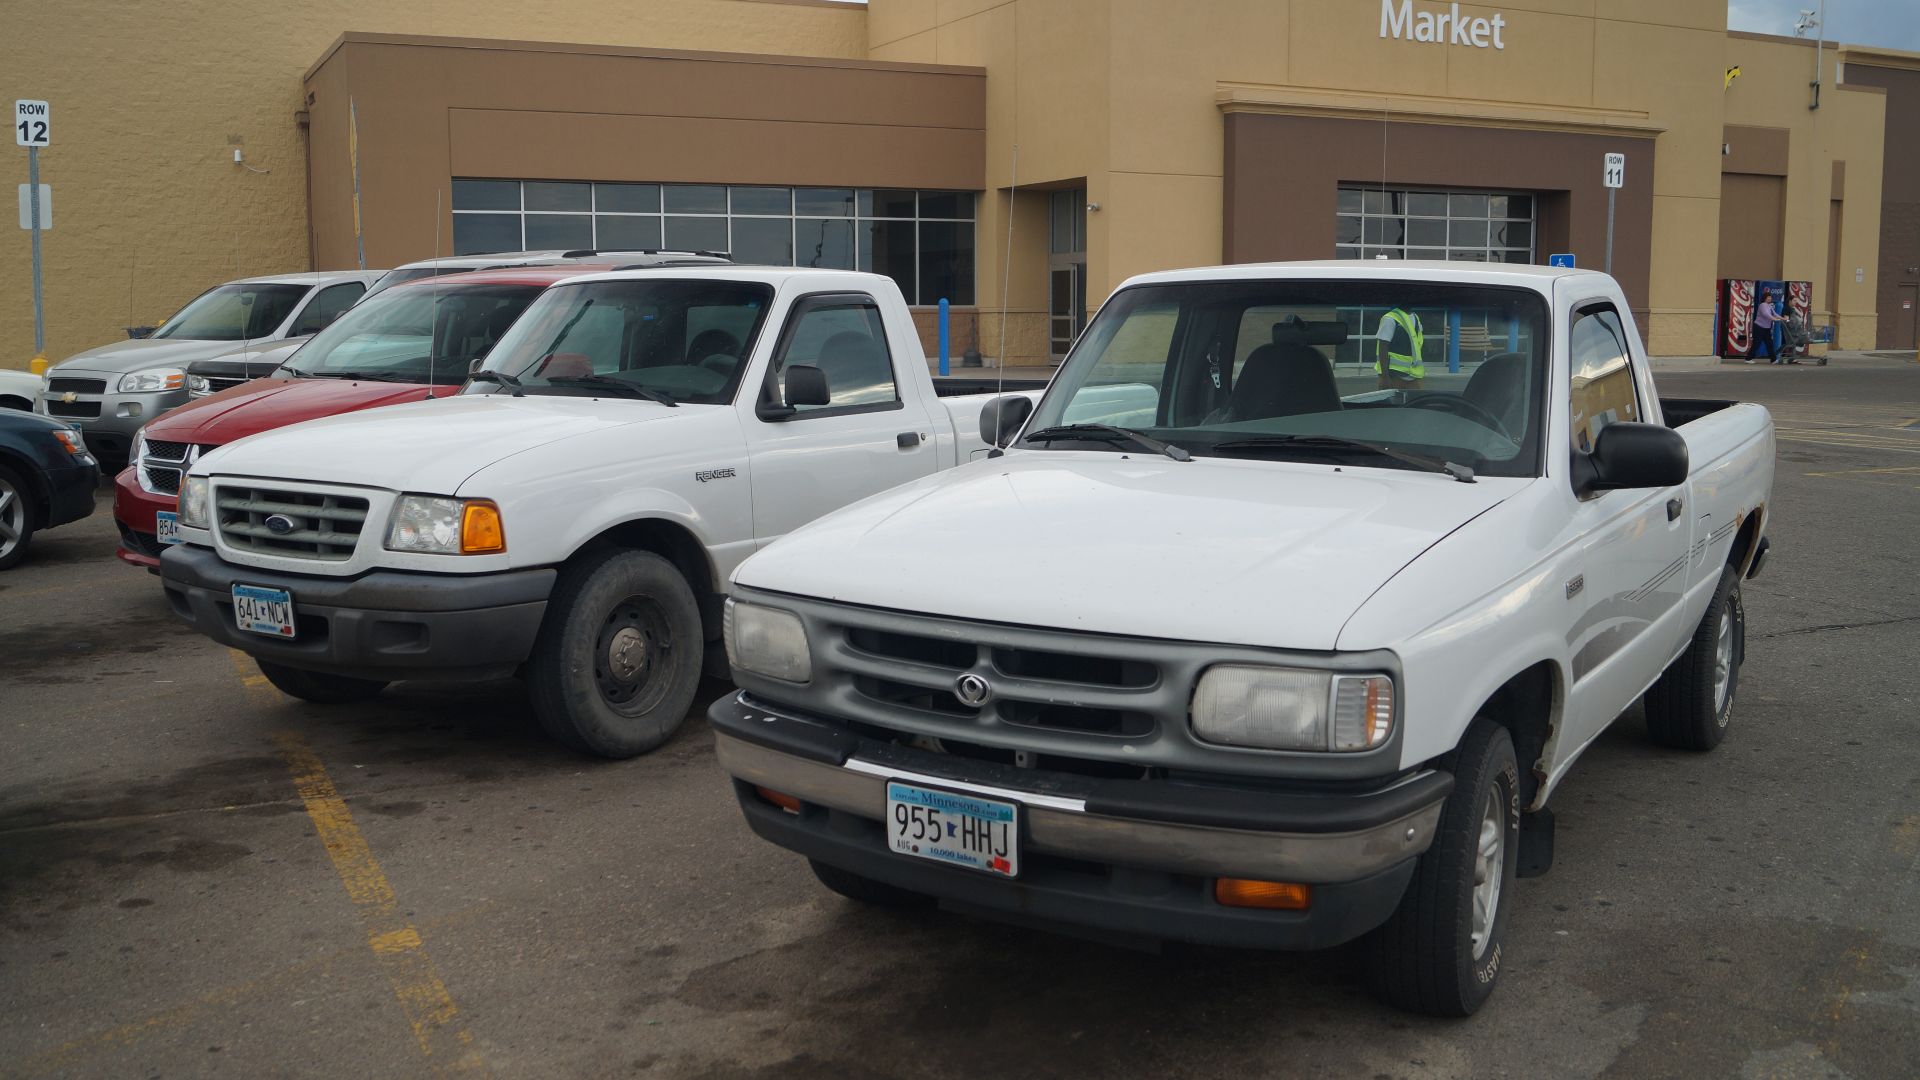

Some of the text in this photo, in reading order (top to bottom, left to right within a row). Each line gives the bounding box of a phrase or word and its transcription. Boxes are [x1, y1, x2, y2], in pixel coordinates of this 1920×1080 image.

[1379, 0, 1506, 49] Market
[19, 103, 46, 115] ROW
[18, 120, 48, 142] 12
[1608, 156, 1623, 165] ROW
[1607, 168, 1622, 185] 11
[695, 467, 737, 483] RANGER
[159, 519, 175, 537] 854
[238, 597, 291, 625] 641 NCW
[895, 803, 1008, 858] 955 HHJ
[896, 839, 911, 851] AUG
